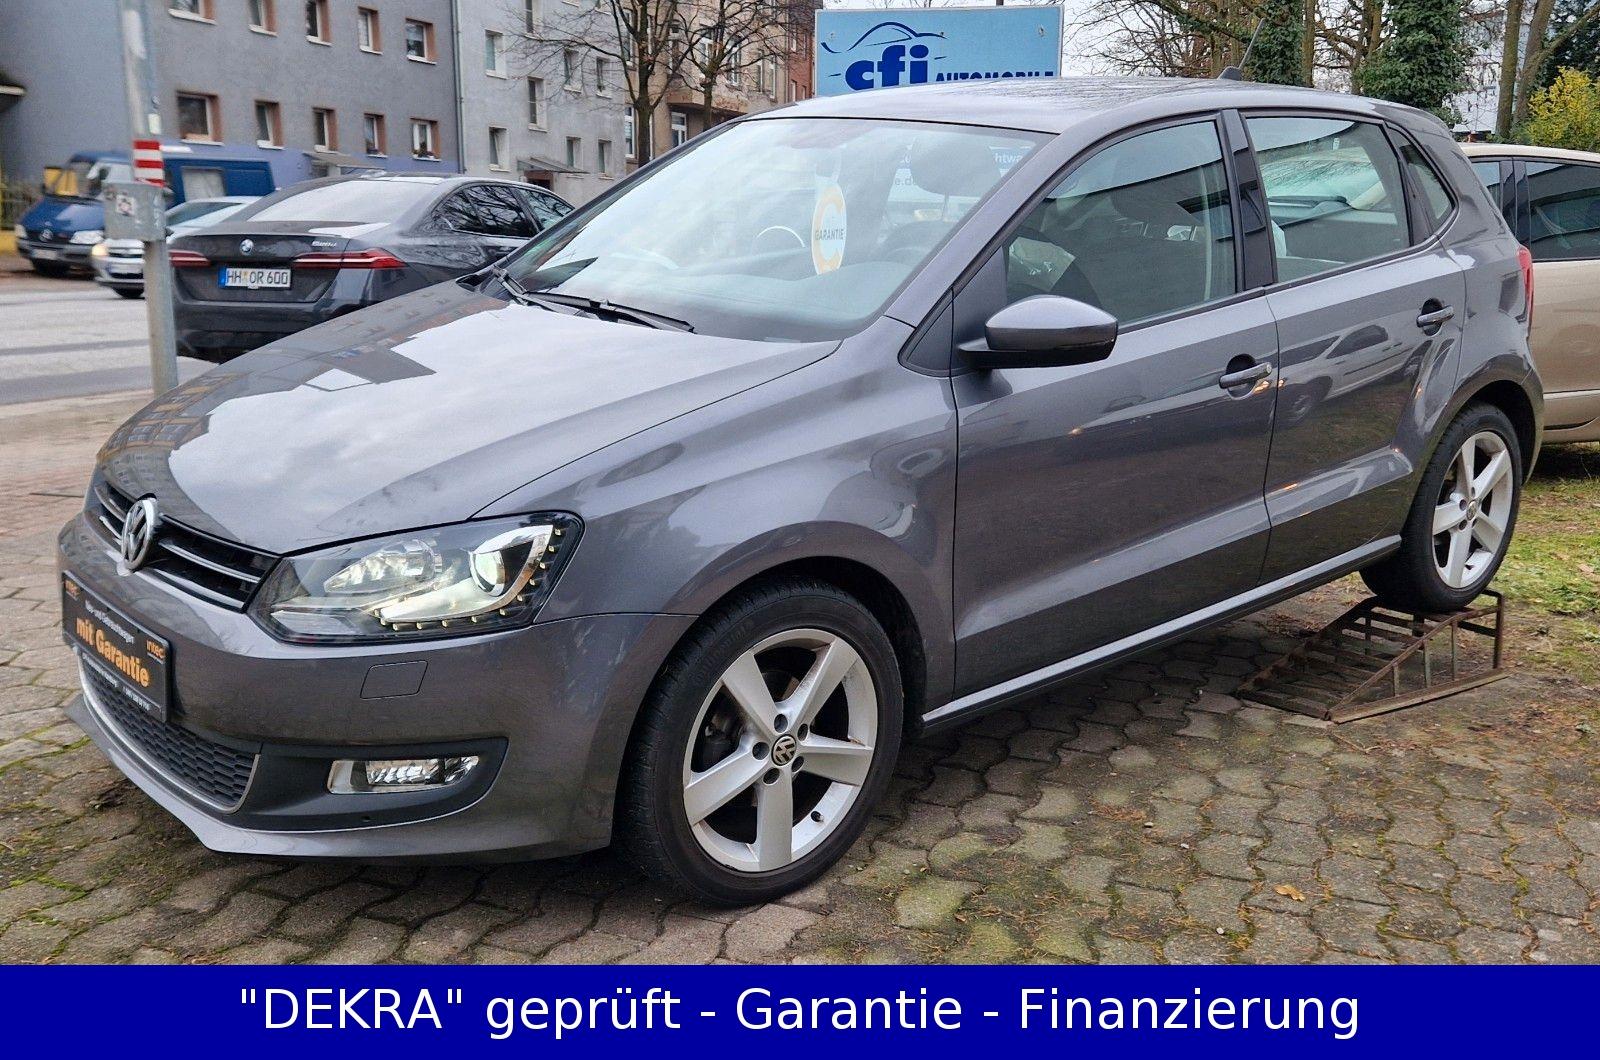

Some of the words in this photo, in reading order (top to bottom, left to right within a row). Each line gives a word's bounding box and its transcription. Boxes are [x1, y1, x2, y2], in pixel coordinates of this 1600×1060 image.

[845, 45, 929, 91] cfi
[815, 229, 844, 241] GARANTIE
[227, 271, 242, 283] HH
[250, 271, 264, 284] OR
[267, 271, 288, 285] 600
[76, 617, 95, 646] mit
[95, 629, 150, 688] Garantie
